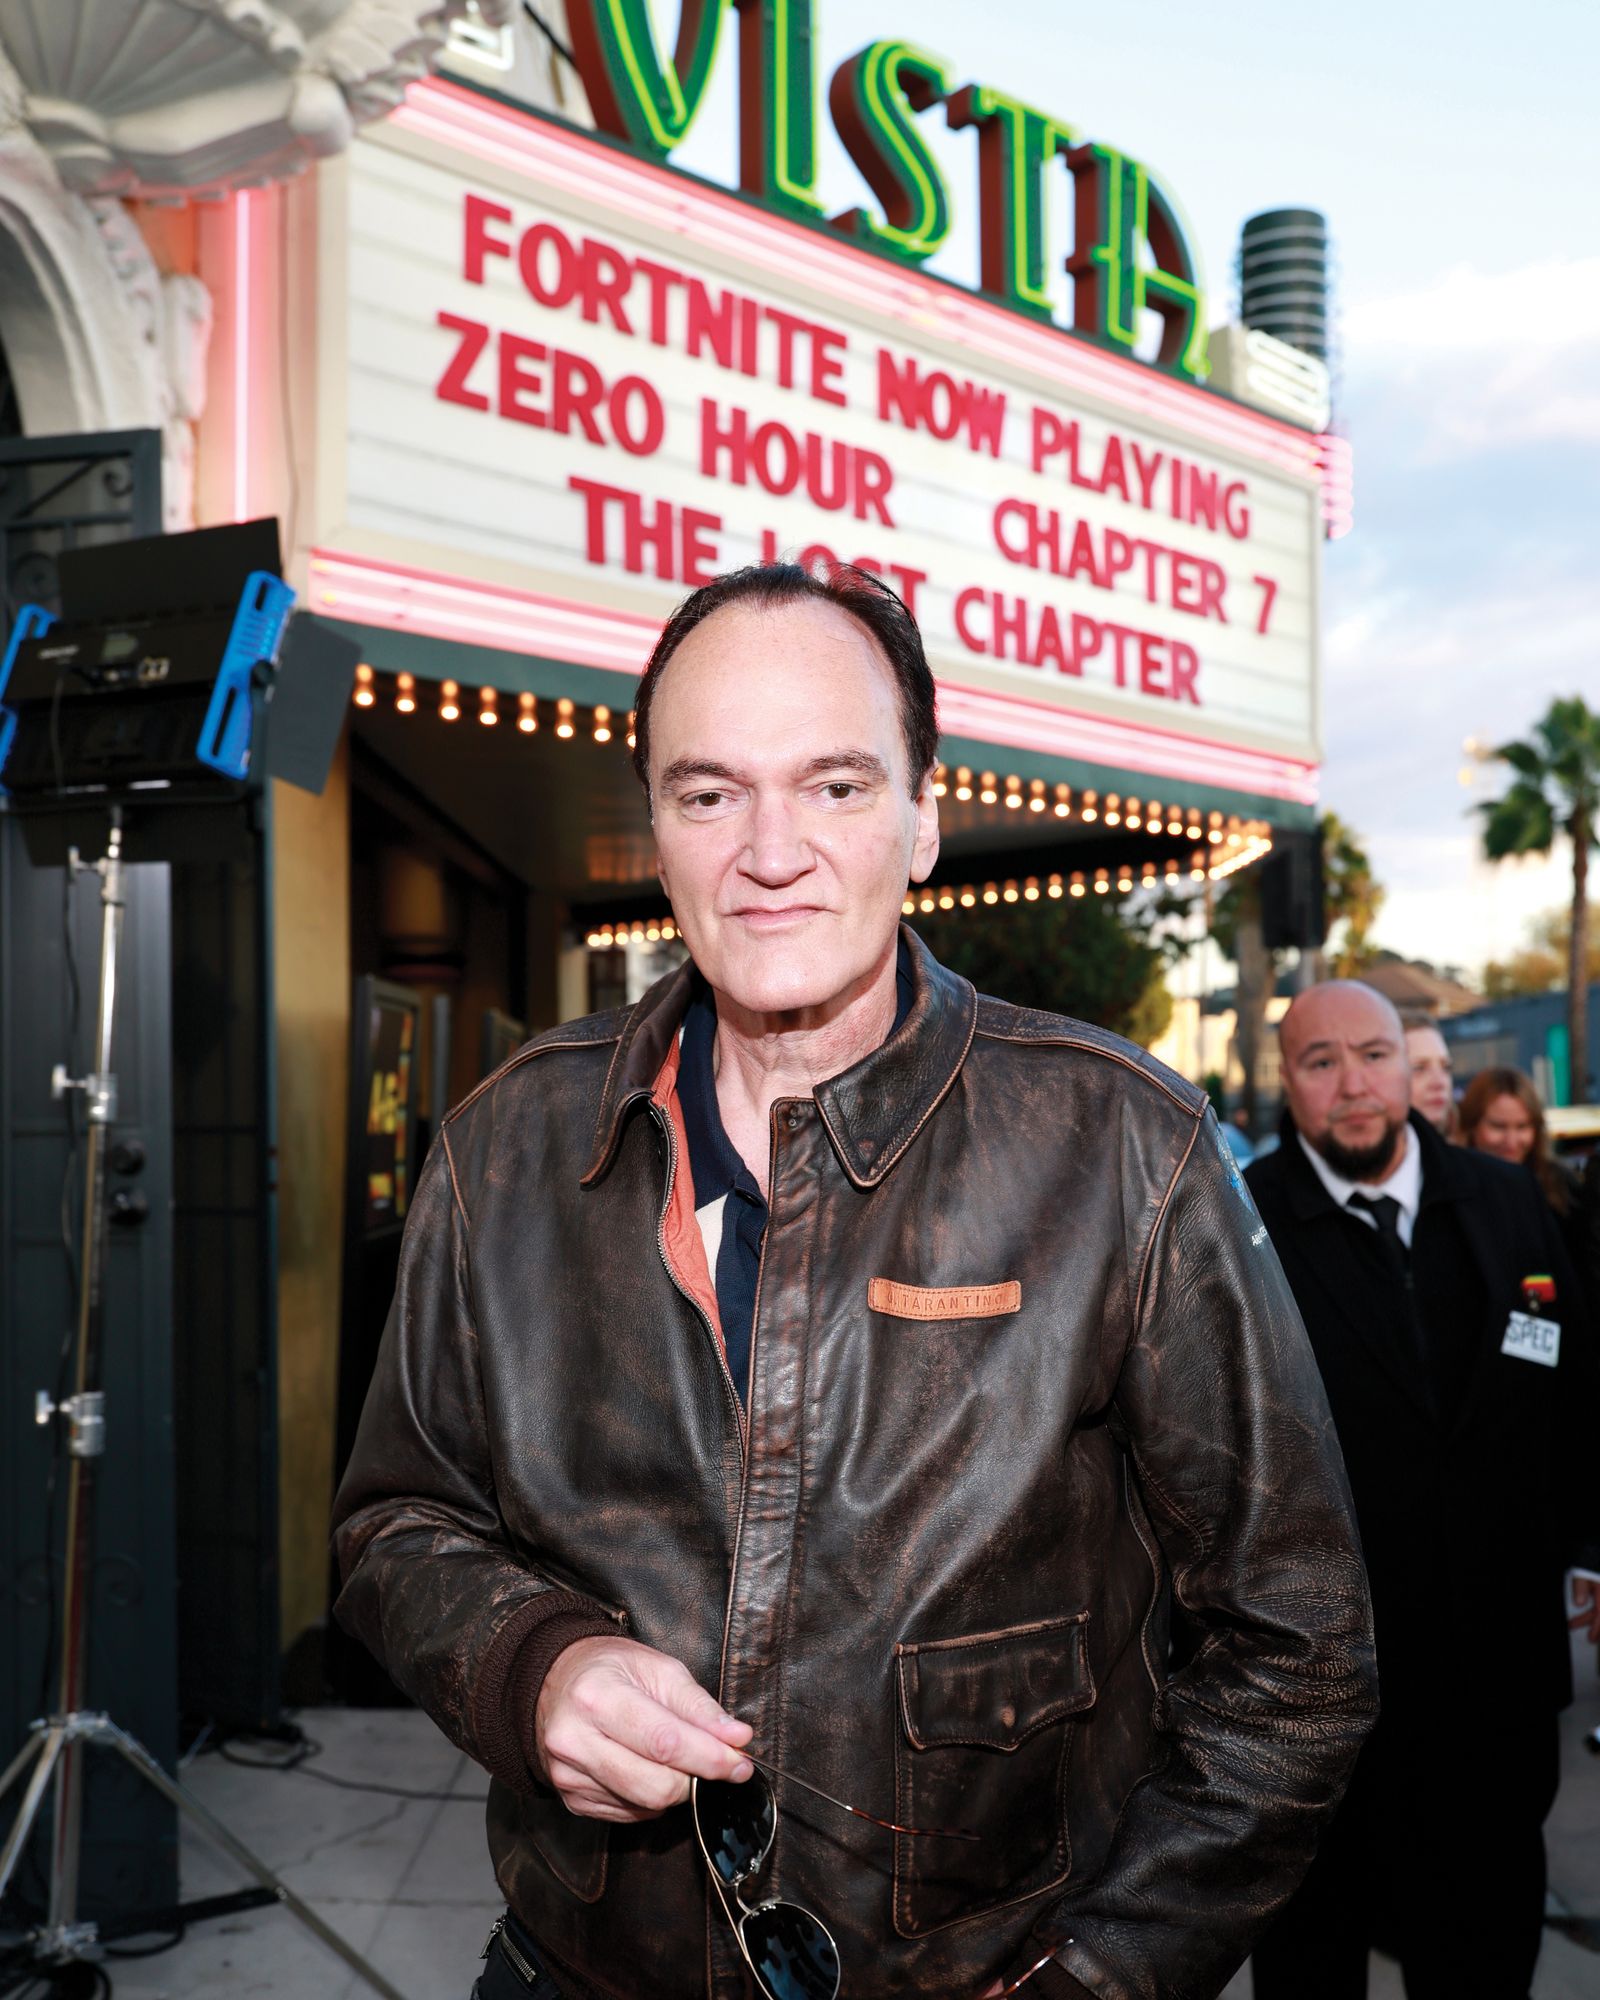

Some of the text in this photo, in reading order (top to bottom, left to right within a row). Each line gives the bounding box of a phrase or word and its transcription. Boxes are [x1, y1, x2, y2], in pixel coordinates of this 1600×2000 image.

[568, 0, 1212, 380] VISTA
[435, 310, 1278, 636] ZERO HOUR CHAPTER 7
[462, 193, 1250, 540] FORTNITE NOW PLAYING
[567, 475, 724, 589] THE
[953, 586, 1201, 706] CHAPTER
